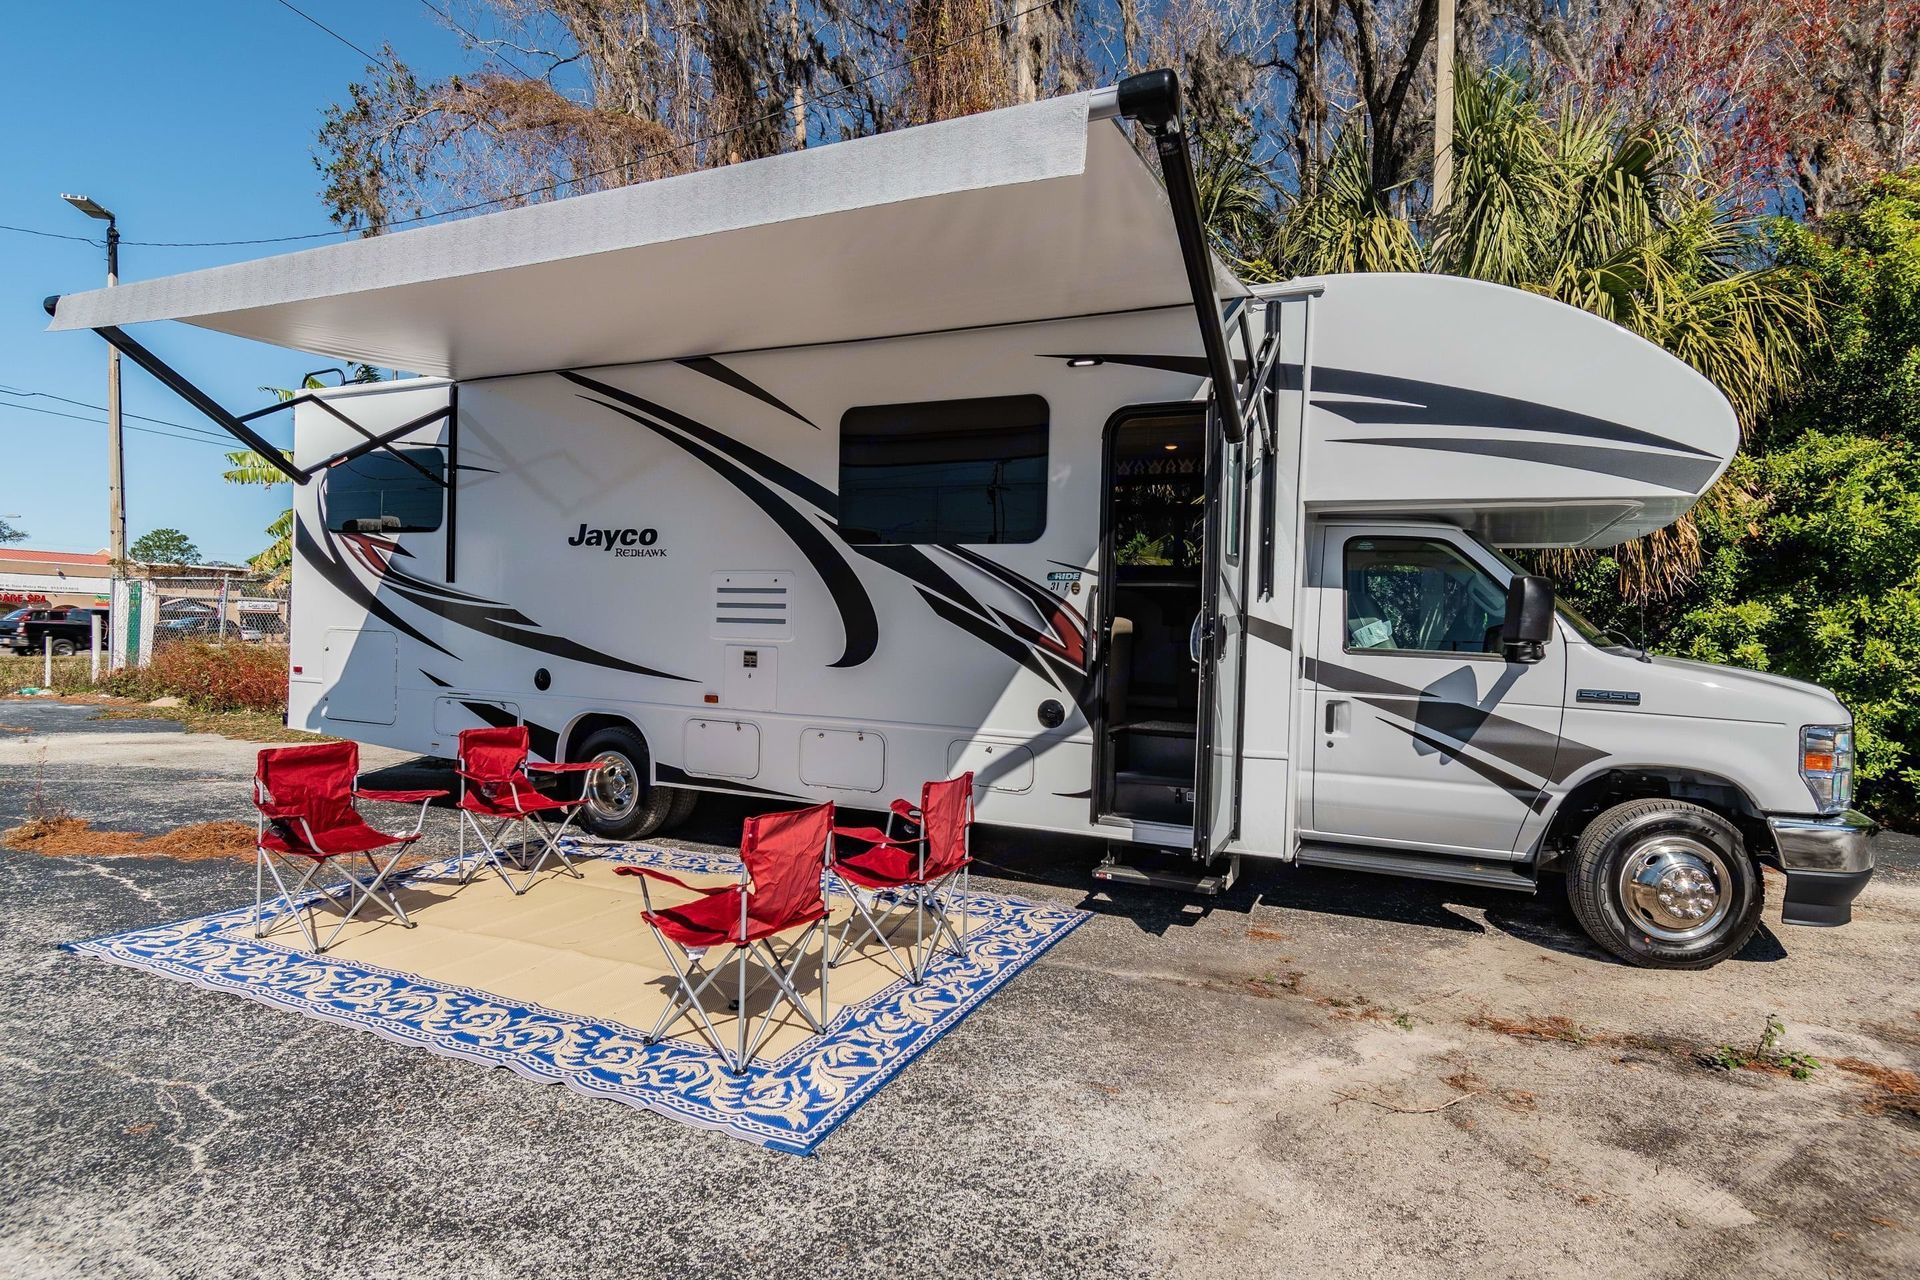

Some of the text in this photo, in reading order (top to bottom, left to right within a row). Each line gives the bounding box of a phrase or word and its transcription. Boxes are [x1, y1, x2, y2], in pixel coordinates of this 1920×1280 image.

[568, 523, 658, 551] Jayco
[615, 548, 667, 558] REDHAWK
[27, 593, 47, 604] SPA
